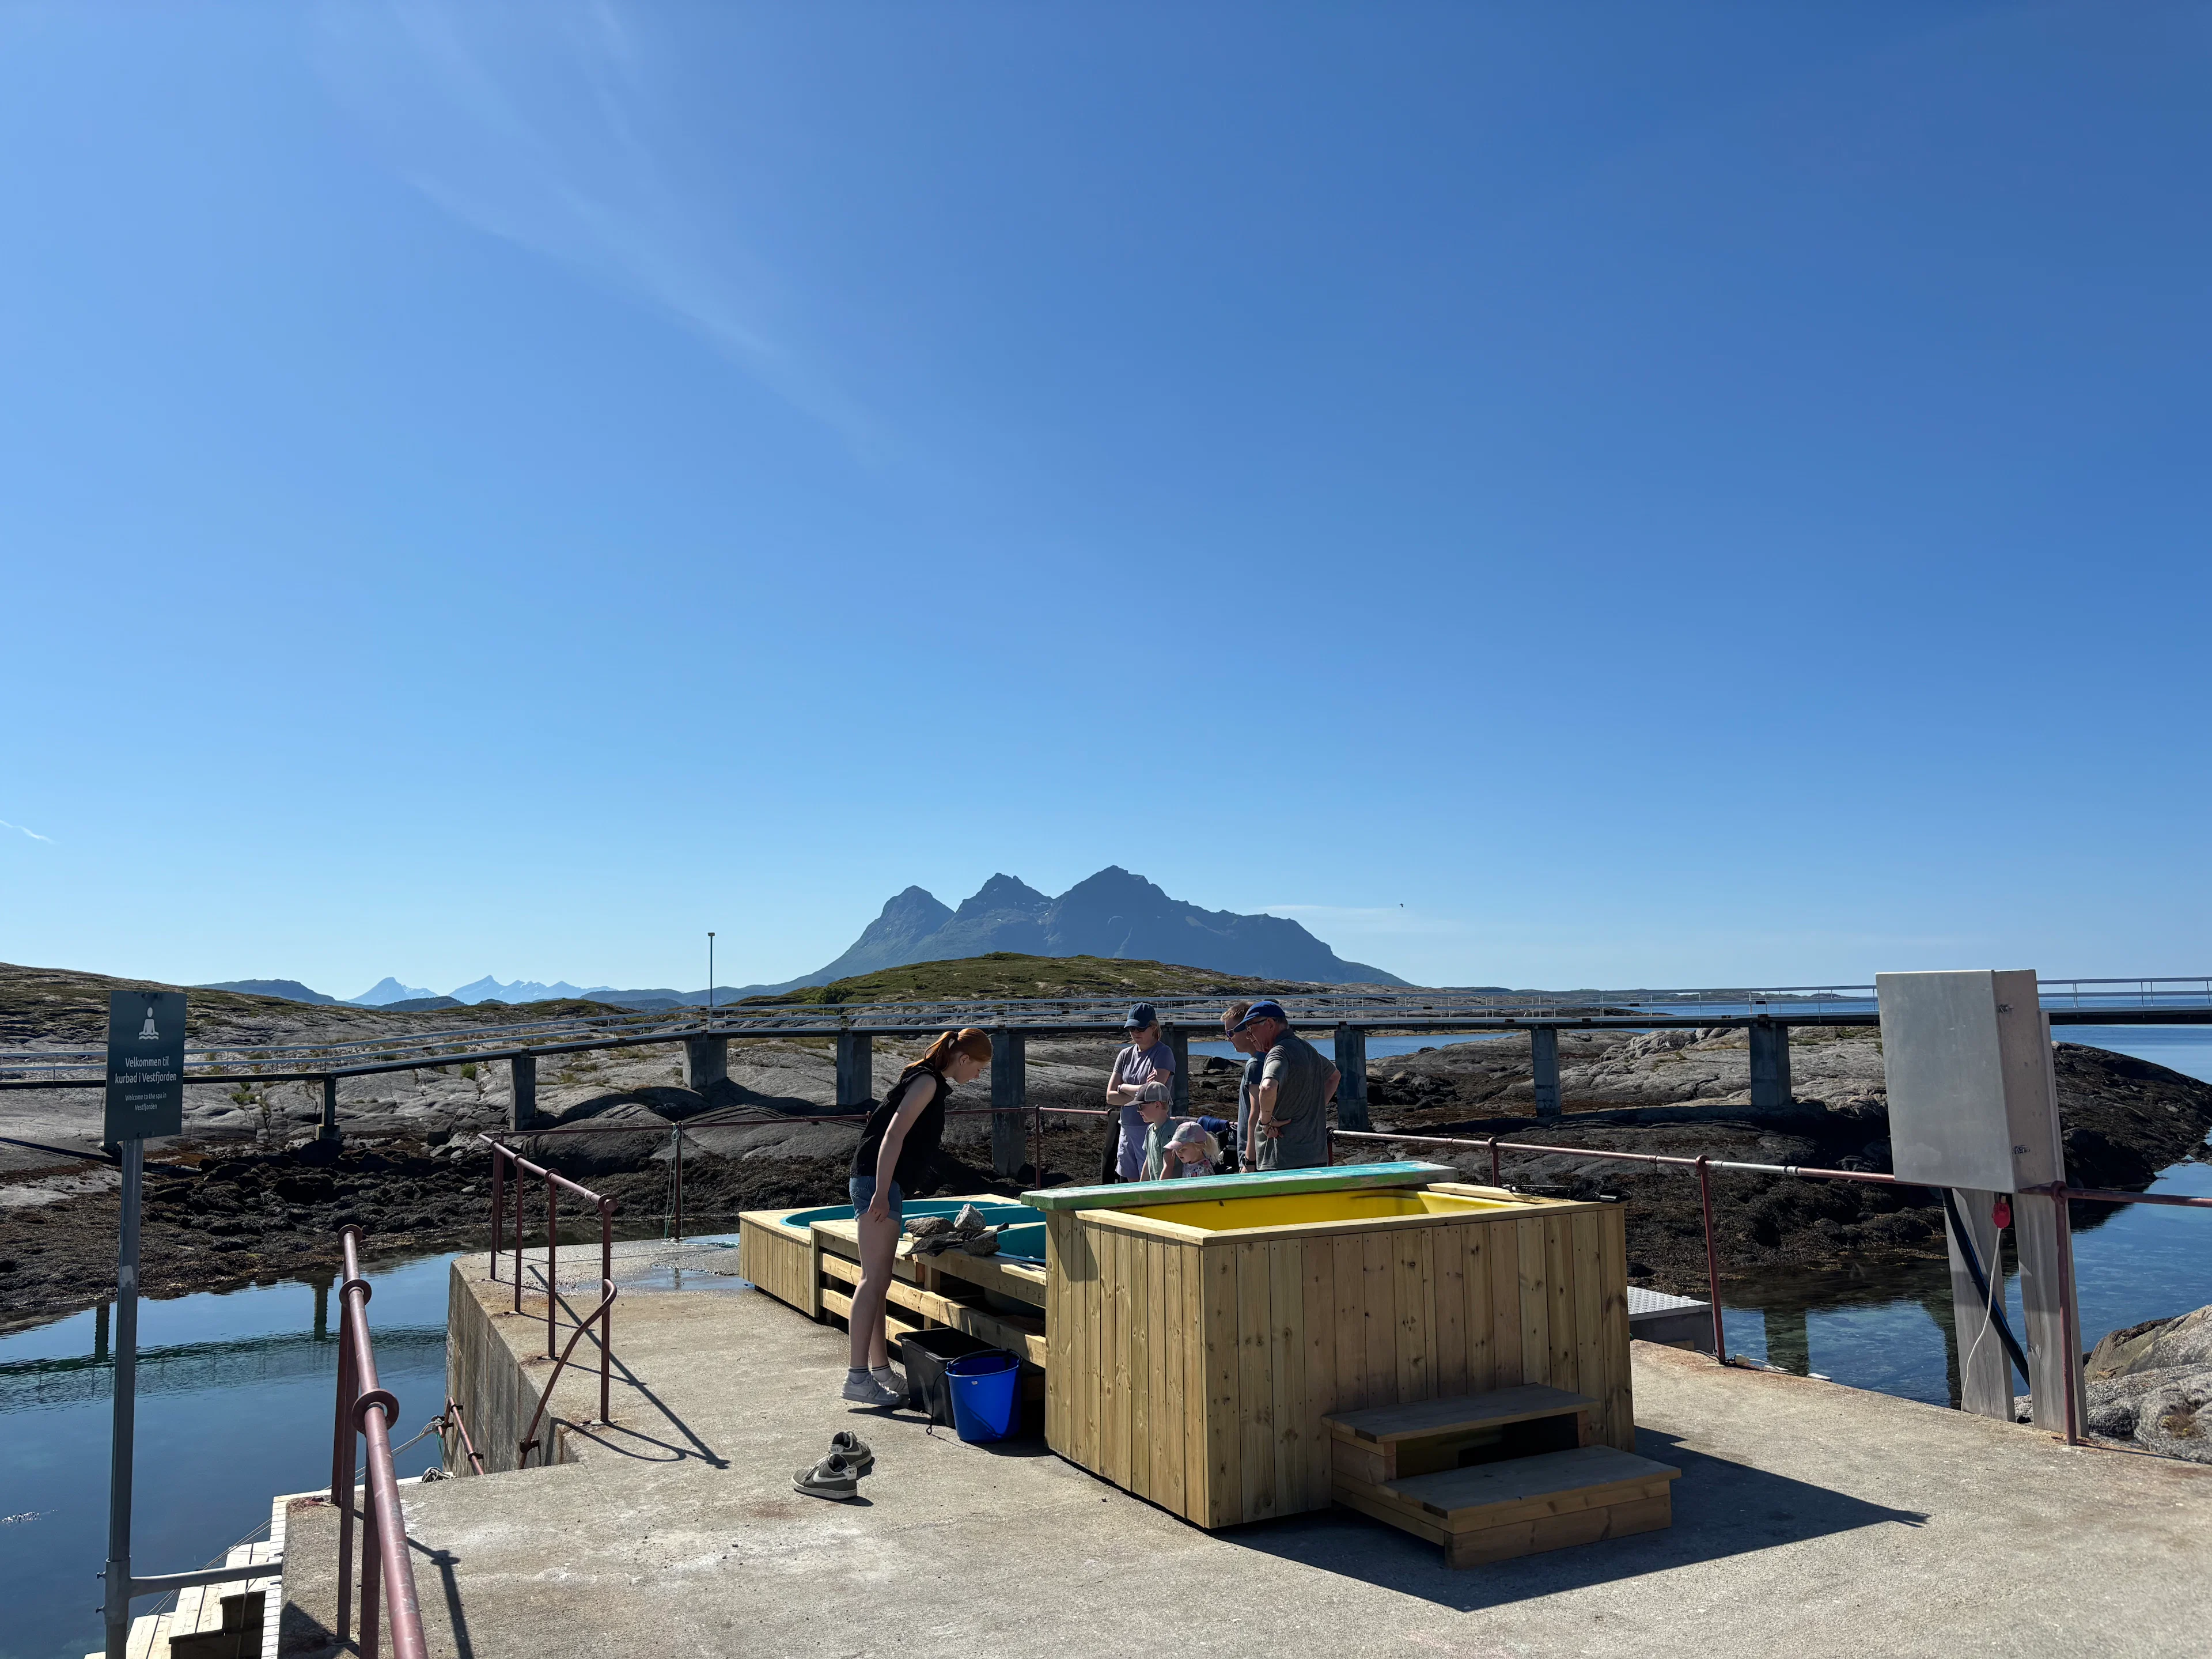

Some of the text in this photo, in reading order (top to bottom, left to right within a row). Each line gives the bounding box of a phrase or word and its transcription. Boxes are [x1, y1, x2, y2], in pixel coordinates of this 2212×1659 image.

[125, 1056, 161, 1067] Velkommen
[115, 1071, 177, 1084] kurbad i Vestfjorden
[134, 1103, 158, 1111] Vestfjorden
